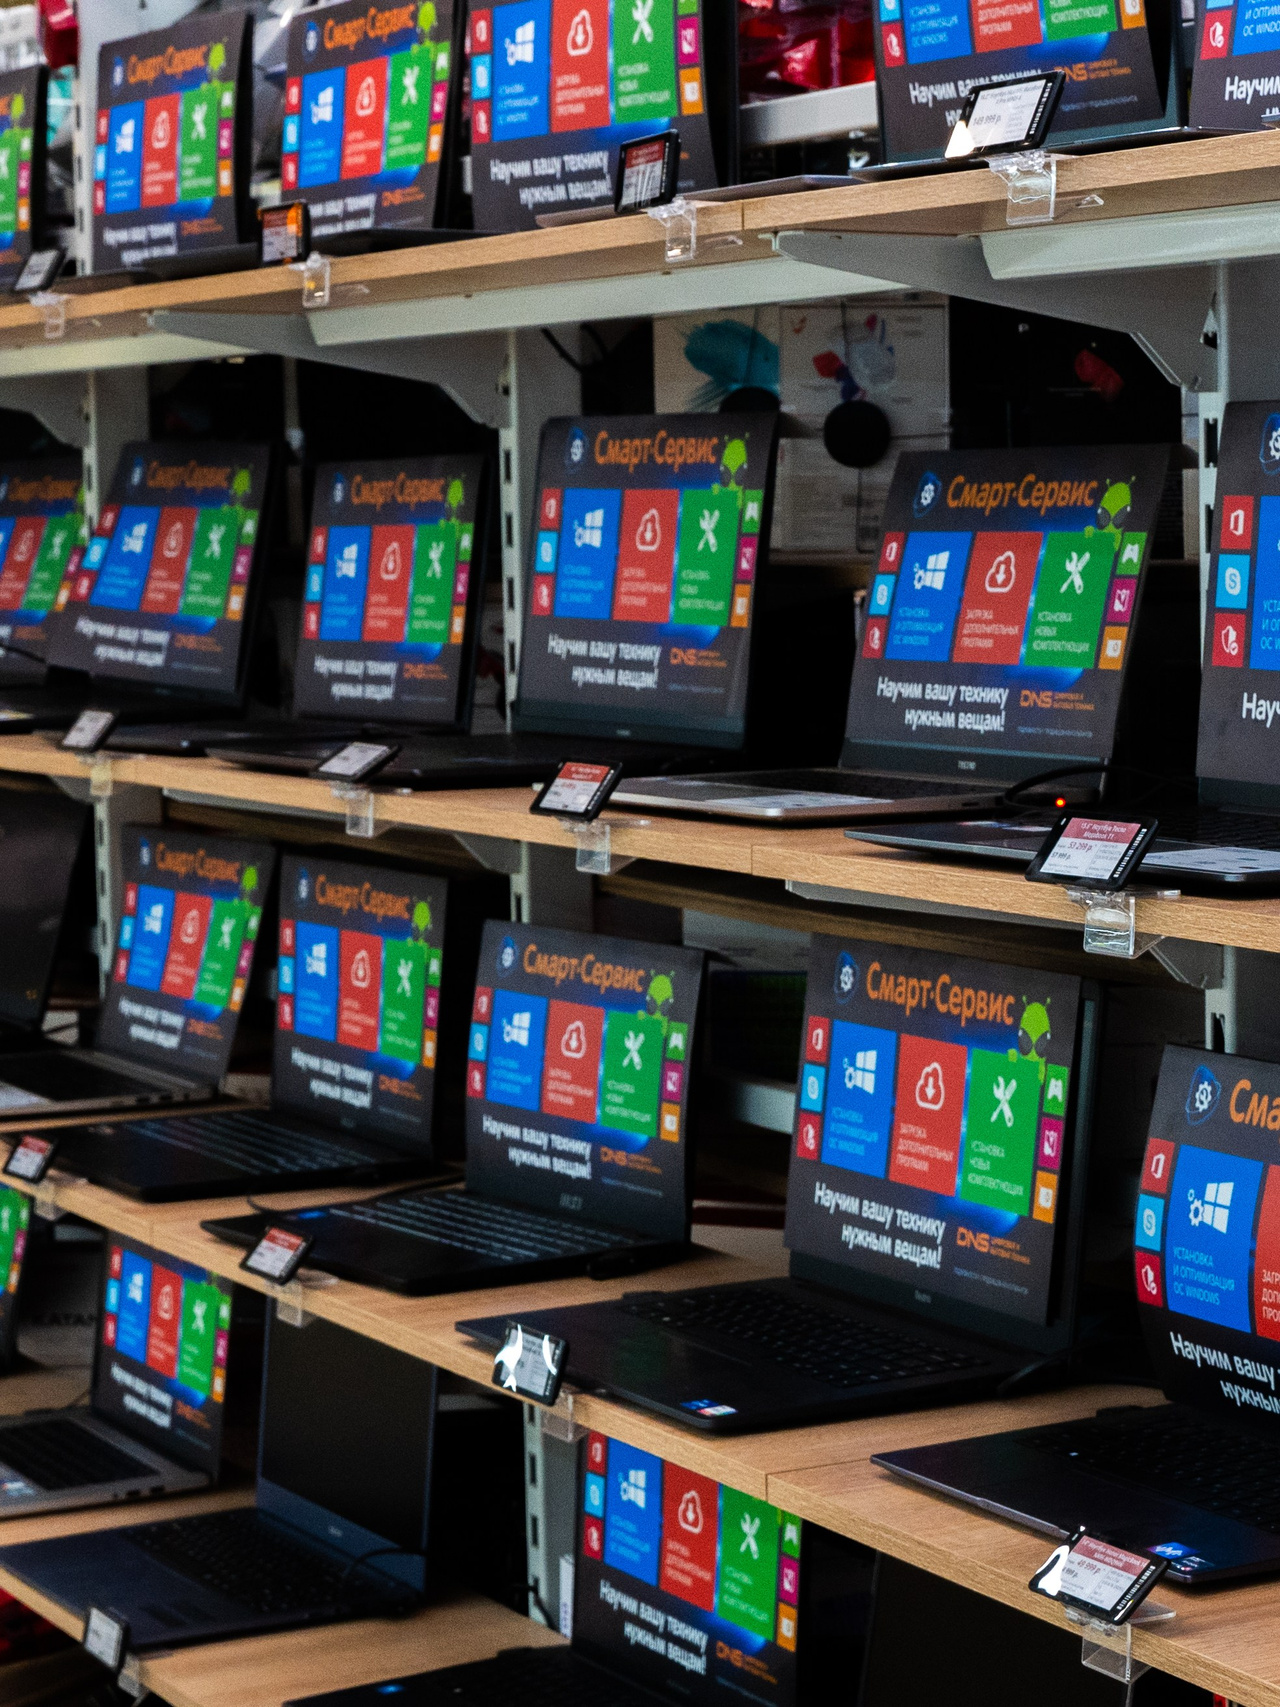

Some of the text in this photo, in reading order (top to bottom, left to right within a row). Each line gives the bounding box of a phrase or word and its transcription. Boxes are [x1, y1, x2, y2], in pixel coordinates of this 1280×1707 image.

[1242, 25, 1254, 37] ОС
[1020, 690, 1052, 707] DNS
[957, 1227, 989, 1252] DNS
[1170, 1331, 1232, 1368] Научим
[1233, 1355, 1275, 1390] вашу
